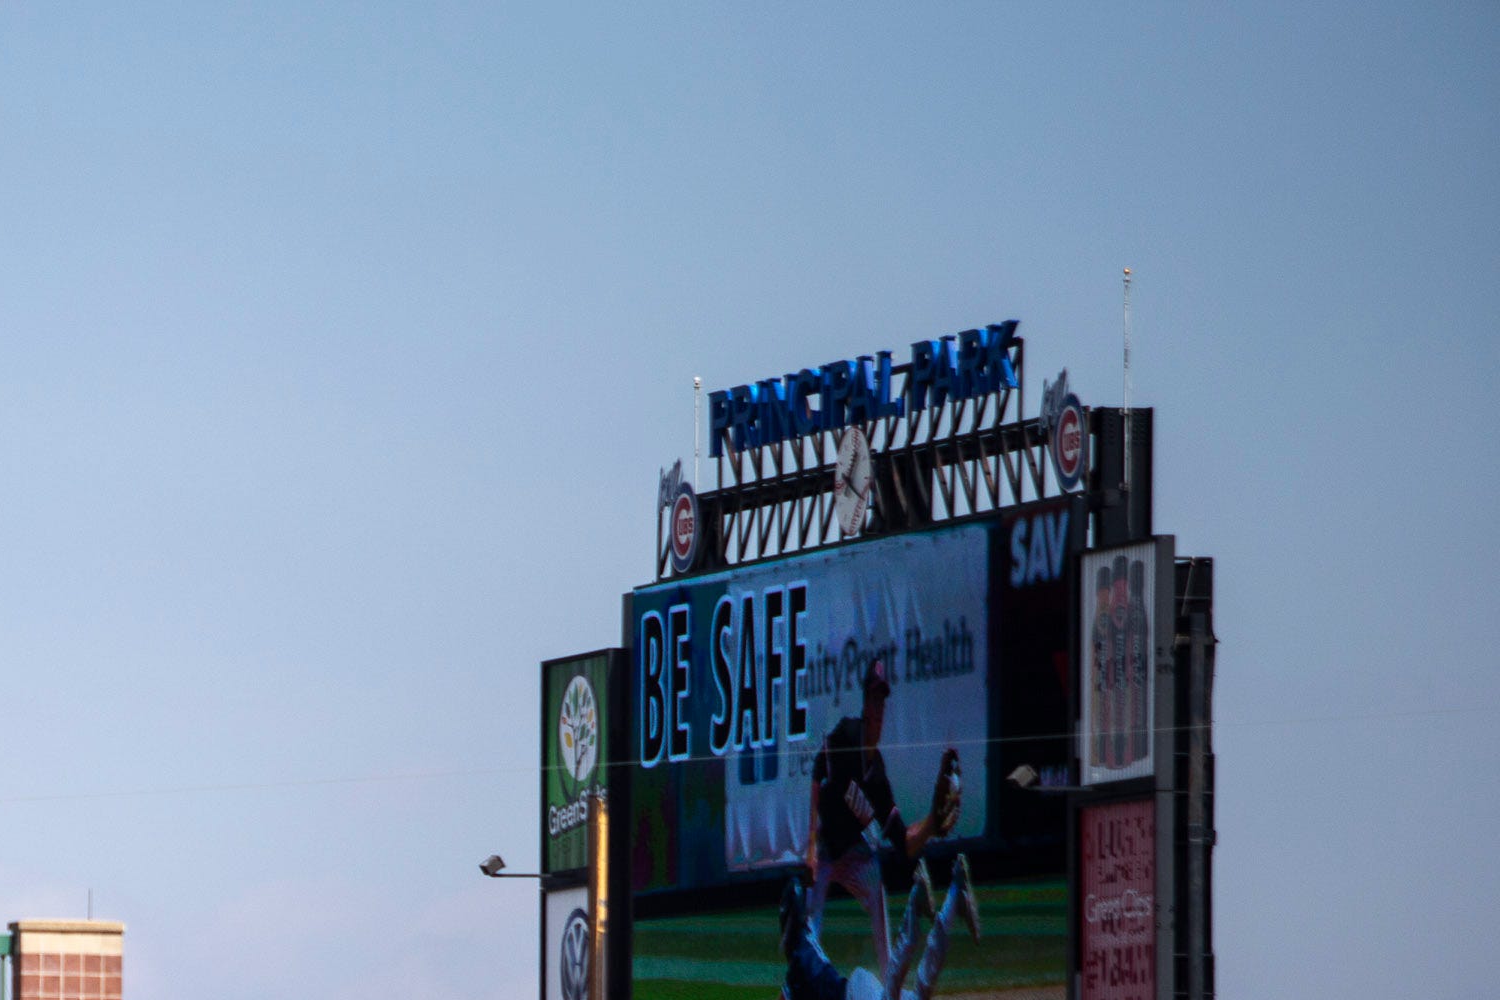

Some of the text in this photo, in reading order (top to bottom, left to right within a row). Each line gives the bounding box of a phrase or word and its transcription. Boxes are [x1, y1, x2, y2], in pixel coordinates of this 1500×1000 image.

[708, 350, 905, 458] PRINCIPAL
[911, 320, 1019, 412] PARK
[641, 579, 809, 768] BE SAFE
[905, 614, 974, 684] Health
